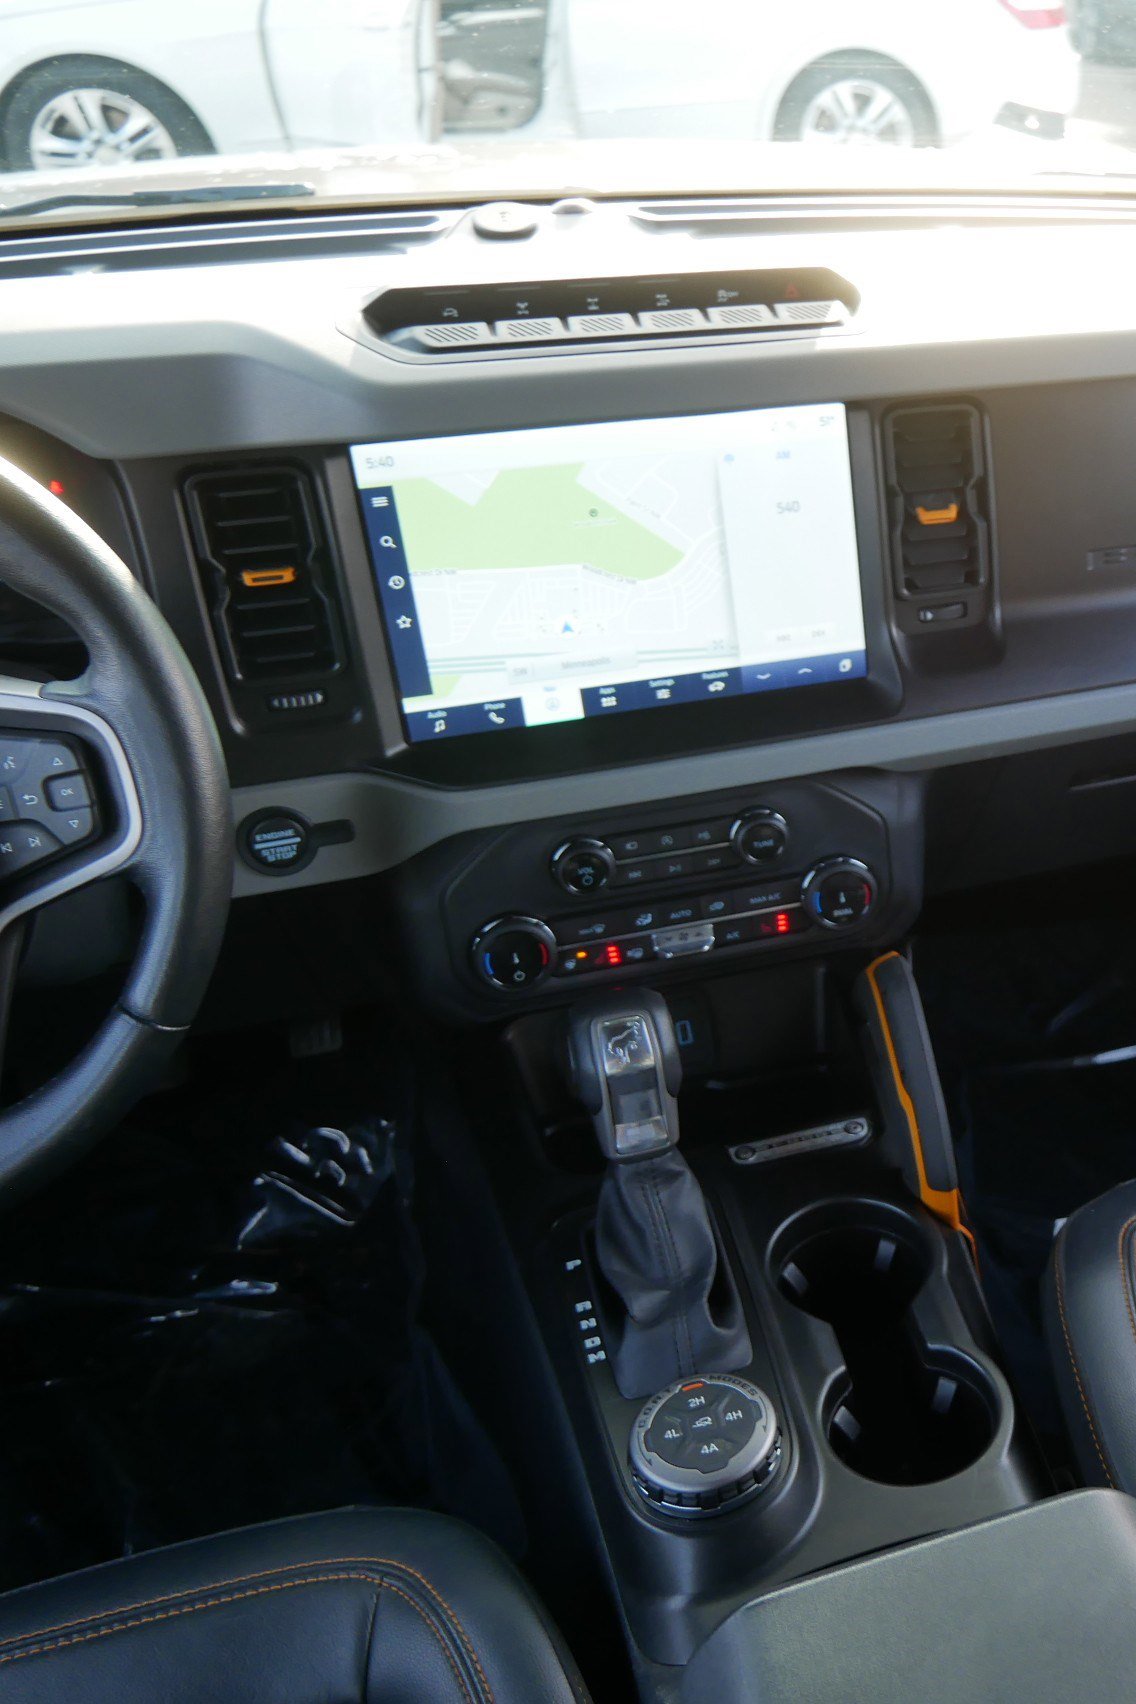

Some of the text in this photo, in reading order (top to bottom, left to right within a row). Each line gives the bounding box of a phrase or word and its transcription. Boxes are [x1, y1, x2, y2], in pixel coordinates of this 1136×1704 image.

[366, 456, 394, 469] 5:40
[776, 501, 801, 514] 540
[60, 788, 74, 796] OK
[255, 829, 296, 842] ENGINE
[260, 845, 298, 857] START
[266, 851, 297, 862] STOP
[577, 866, 593, 874] VOL
[670, 909, 692, 919] AUTO
[566, 1259, 582, 1271] P
[575, 1300, 593, 1313] R
[579, 1317, 598, 1331] N
[583, 1336, 602, 1350] D
[587, 1350, 606, 1364] M
[708, 1374, 758, 1397] MODES
[687, 1395, 706, 1408] 2H
[725, 1409, 743, 1421] 4H
[664, 1428, 681, 1439] 4L
[700, 1442, 719, 1454] 4A
